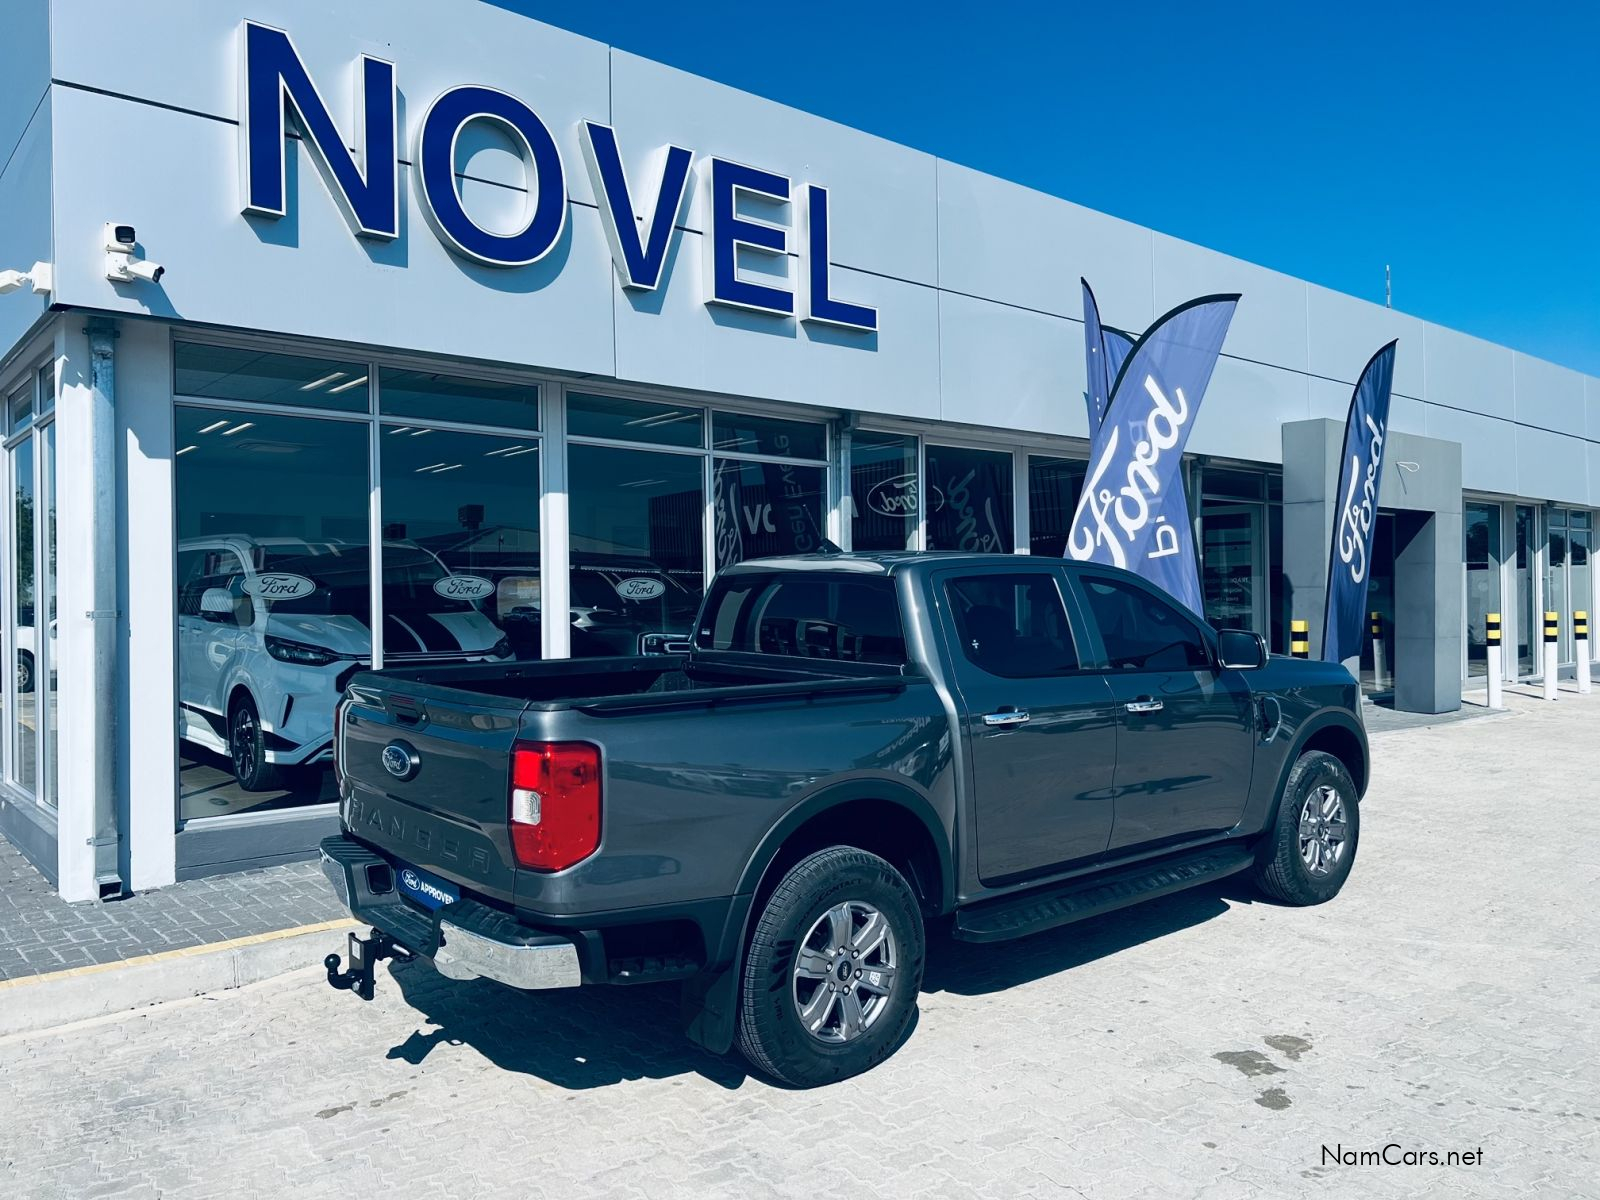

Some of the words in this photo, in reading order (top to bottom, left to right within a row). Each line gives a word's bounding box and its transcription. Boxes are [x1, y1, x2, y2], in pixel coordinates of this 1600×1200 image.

[240, 18, 878, 332] NOVEL
[1068, 374, 1188, 569] Ford
[1339, 413, 1384, 583] Ford
[259, 577, 300, 595] Ford
[446, 578, 482, 595] Ford
[626, 580, 655, 595] Ford
[350, 797, 491, 874] RANGER
[420, 881, 454, 904] APPROVED
